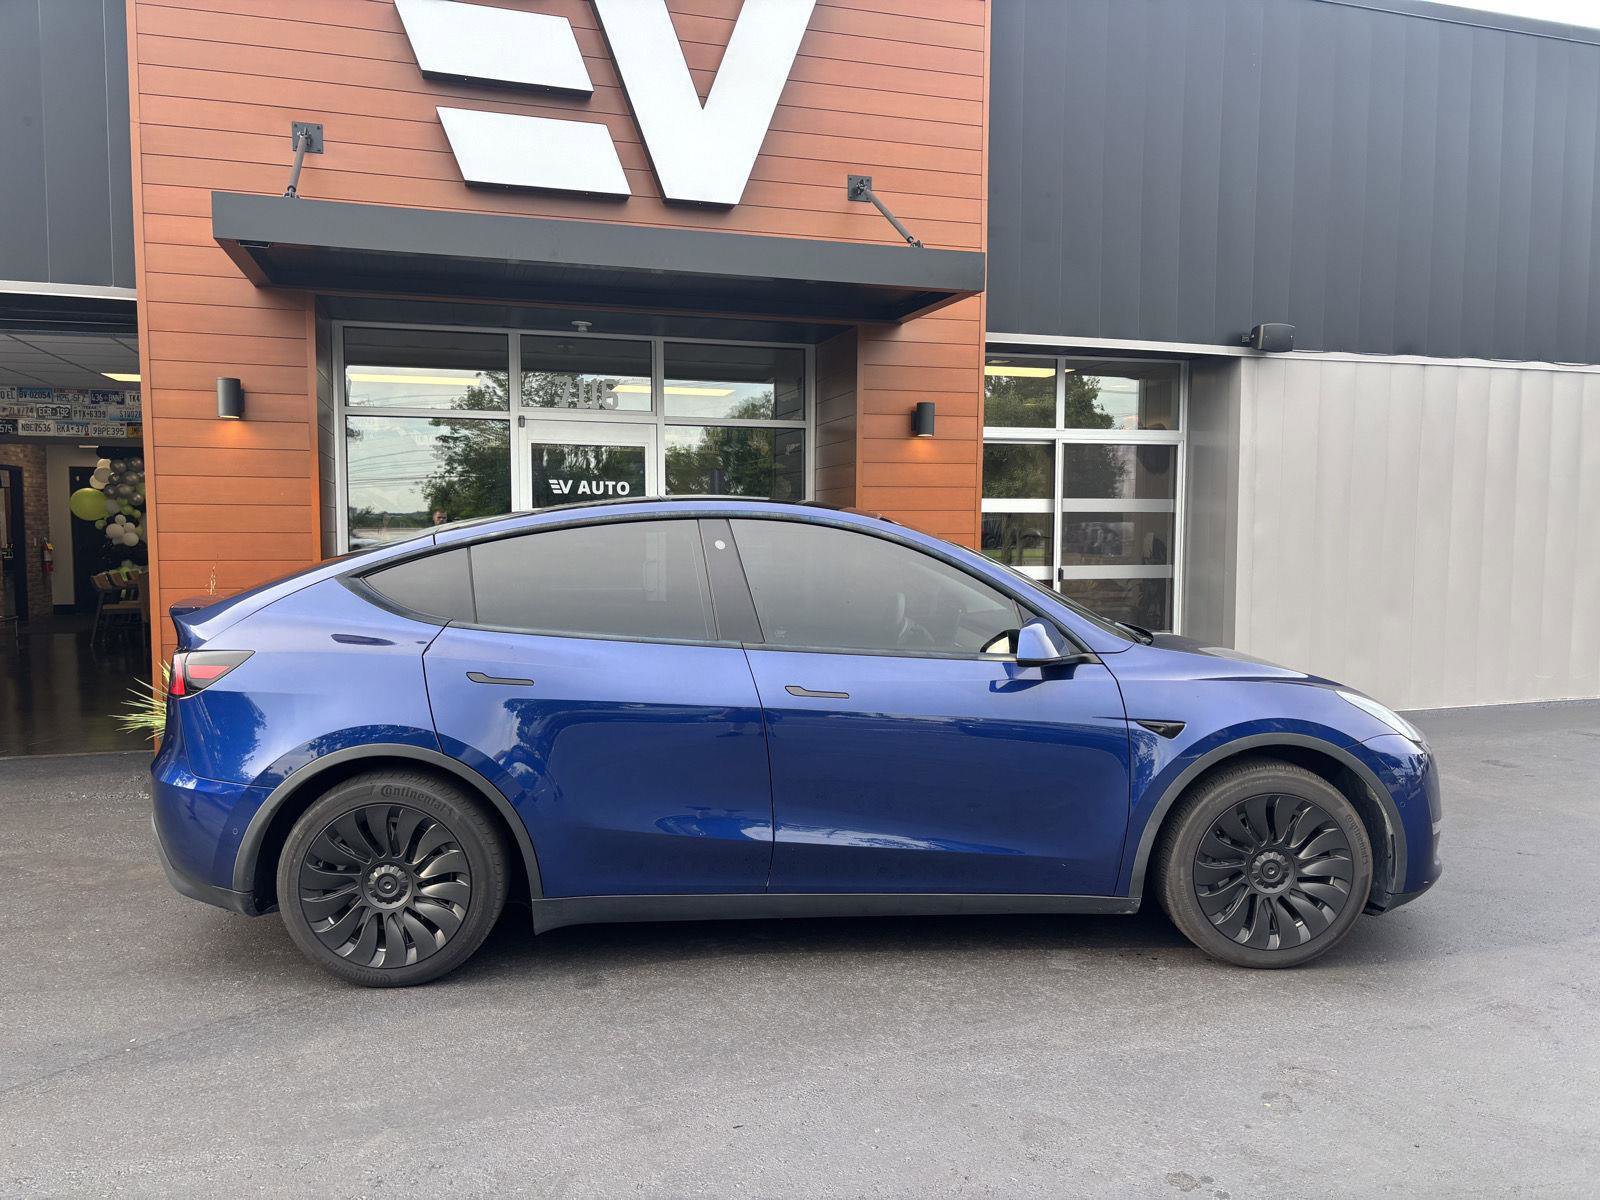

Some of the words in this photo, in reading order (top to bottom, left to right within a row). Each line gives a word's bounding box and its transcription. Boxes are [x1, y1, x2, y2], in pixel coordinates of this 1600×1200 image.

[393, 0, 817, 207] EV
[548, 479, 573, 494] EV
[577, 480, 630, 495] AUTO
[380, 784, 447, 811] Continental
